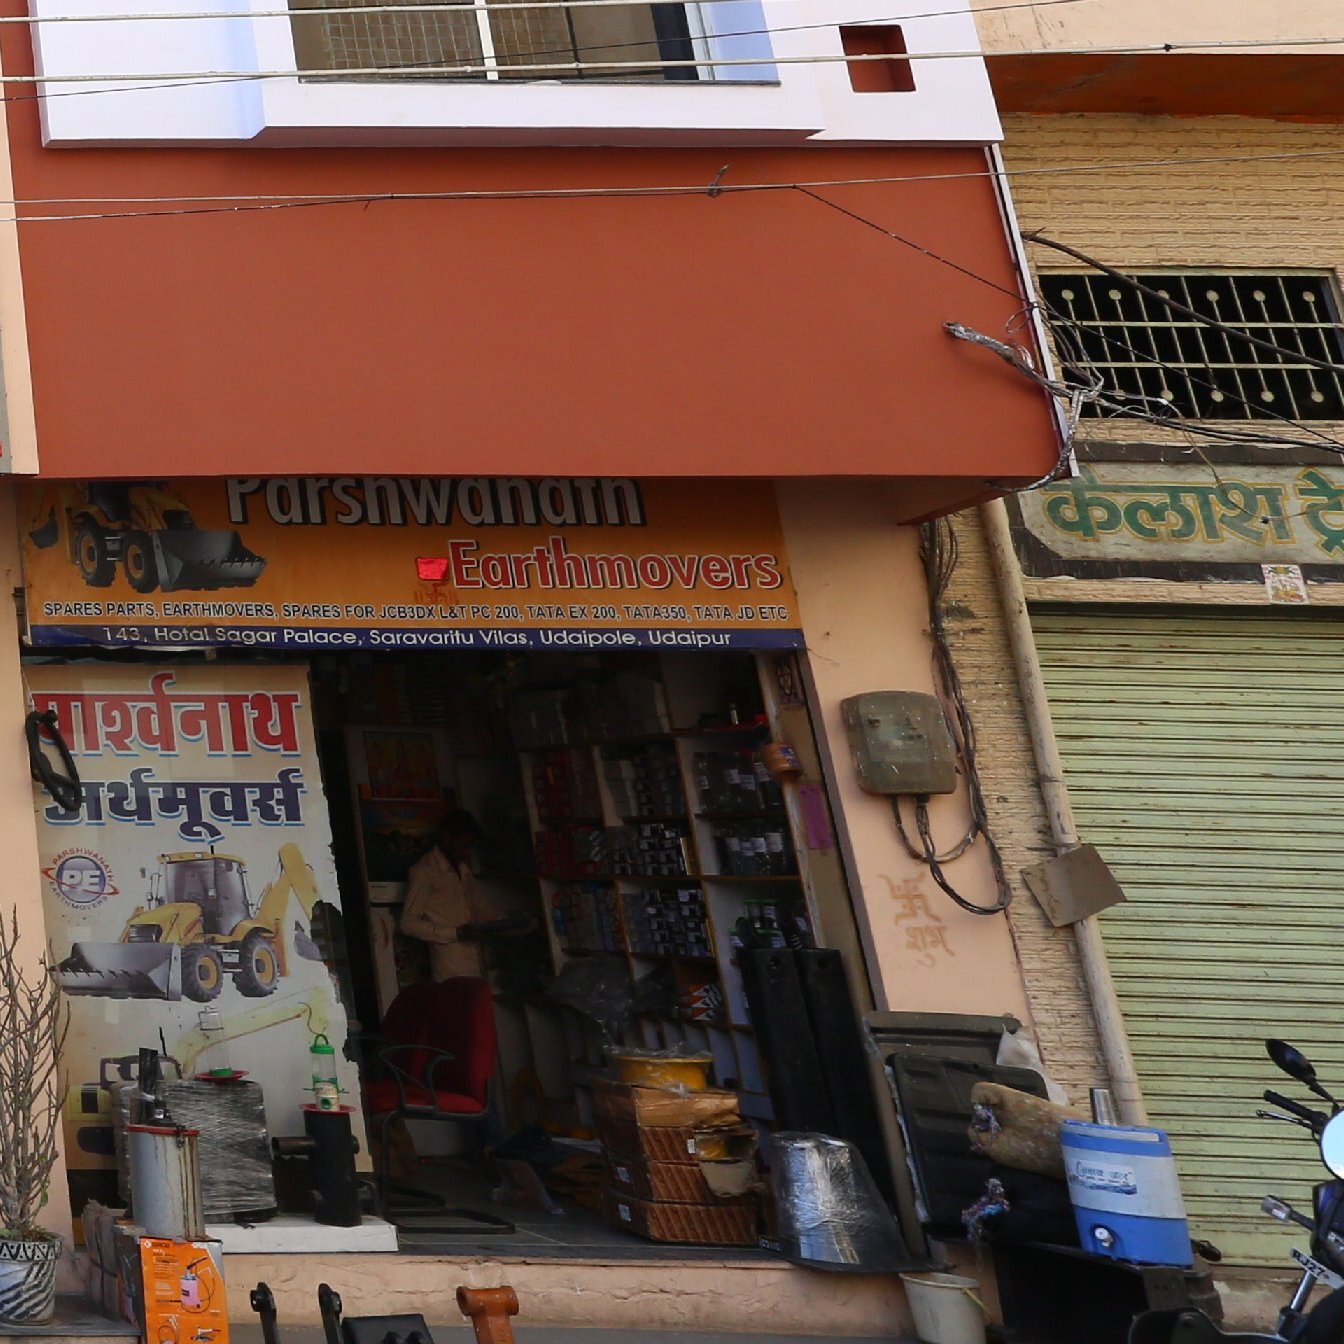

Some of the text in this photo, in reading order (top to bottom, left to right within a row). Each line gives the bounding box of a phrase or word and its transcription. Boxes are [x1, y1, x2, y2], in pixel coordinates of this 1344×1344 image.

[447, 536, 784, 590] Earthmovers
[43, 602, 102, 617] SPARES
[106, 602, 160, 619] PARTS,
[163, 602, 279, 620] EARTHMOVERS,
[281, 604, 341, 619] SPARES
[345, 605, 375, 619] FOR
[378, 605, 436, 619] JCB3DX
[439, 605, 466, 619] L&T
[471, 605, 491, 619] PC
[494, 605, 523, 621] 200,
[526, 605, 566, 619] TATA
[569, 605, 589, 619] EX
[592, 605, 621, 621] 200,
[693, 605, 733, 620] TATA
[736, 605, 755, 620] JD
[758, 606, 789, 620] ETC
[154, 627, 209, 641] Hotal
[215, 628, 277, 645] Sagar
[283, 629, 363, 646] Palace,
[369, 629, 474, 645] Saravaritu
[479, 629, 533, 647] Vilas,
[540, 630, 642, 647] Udaipole,
[648, 630, 731, 647] Udaipur
[52, 847, 114, 882] PARSHWANATH
